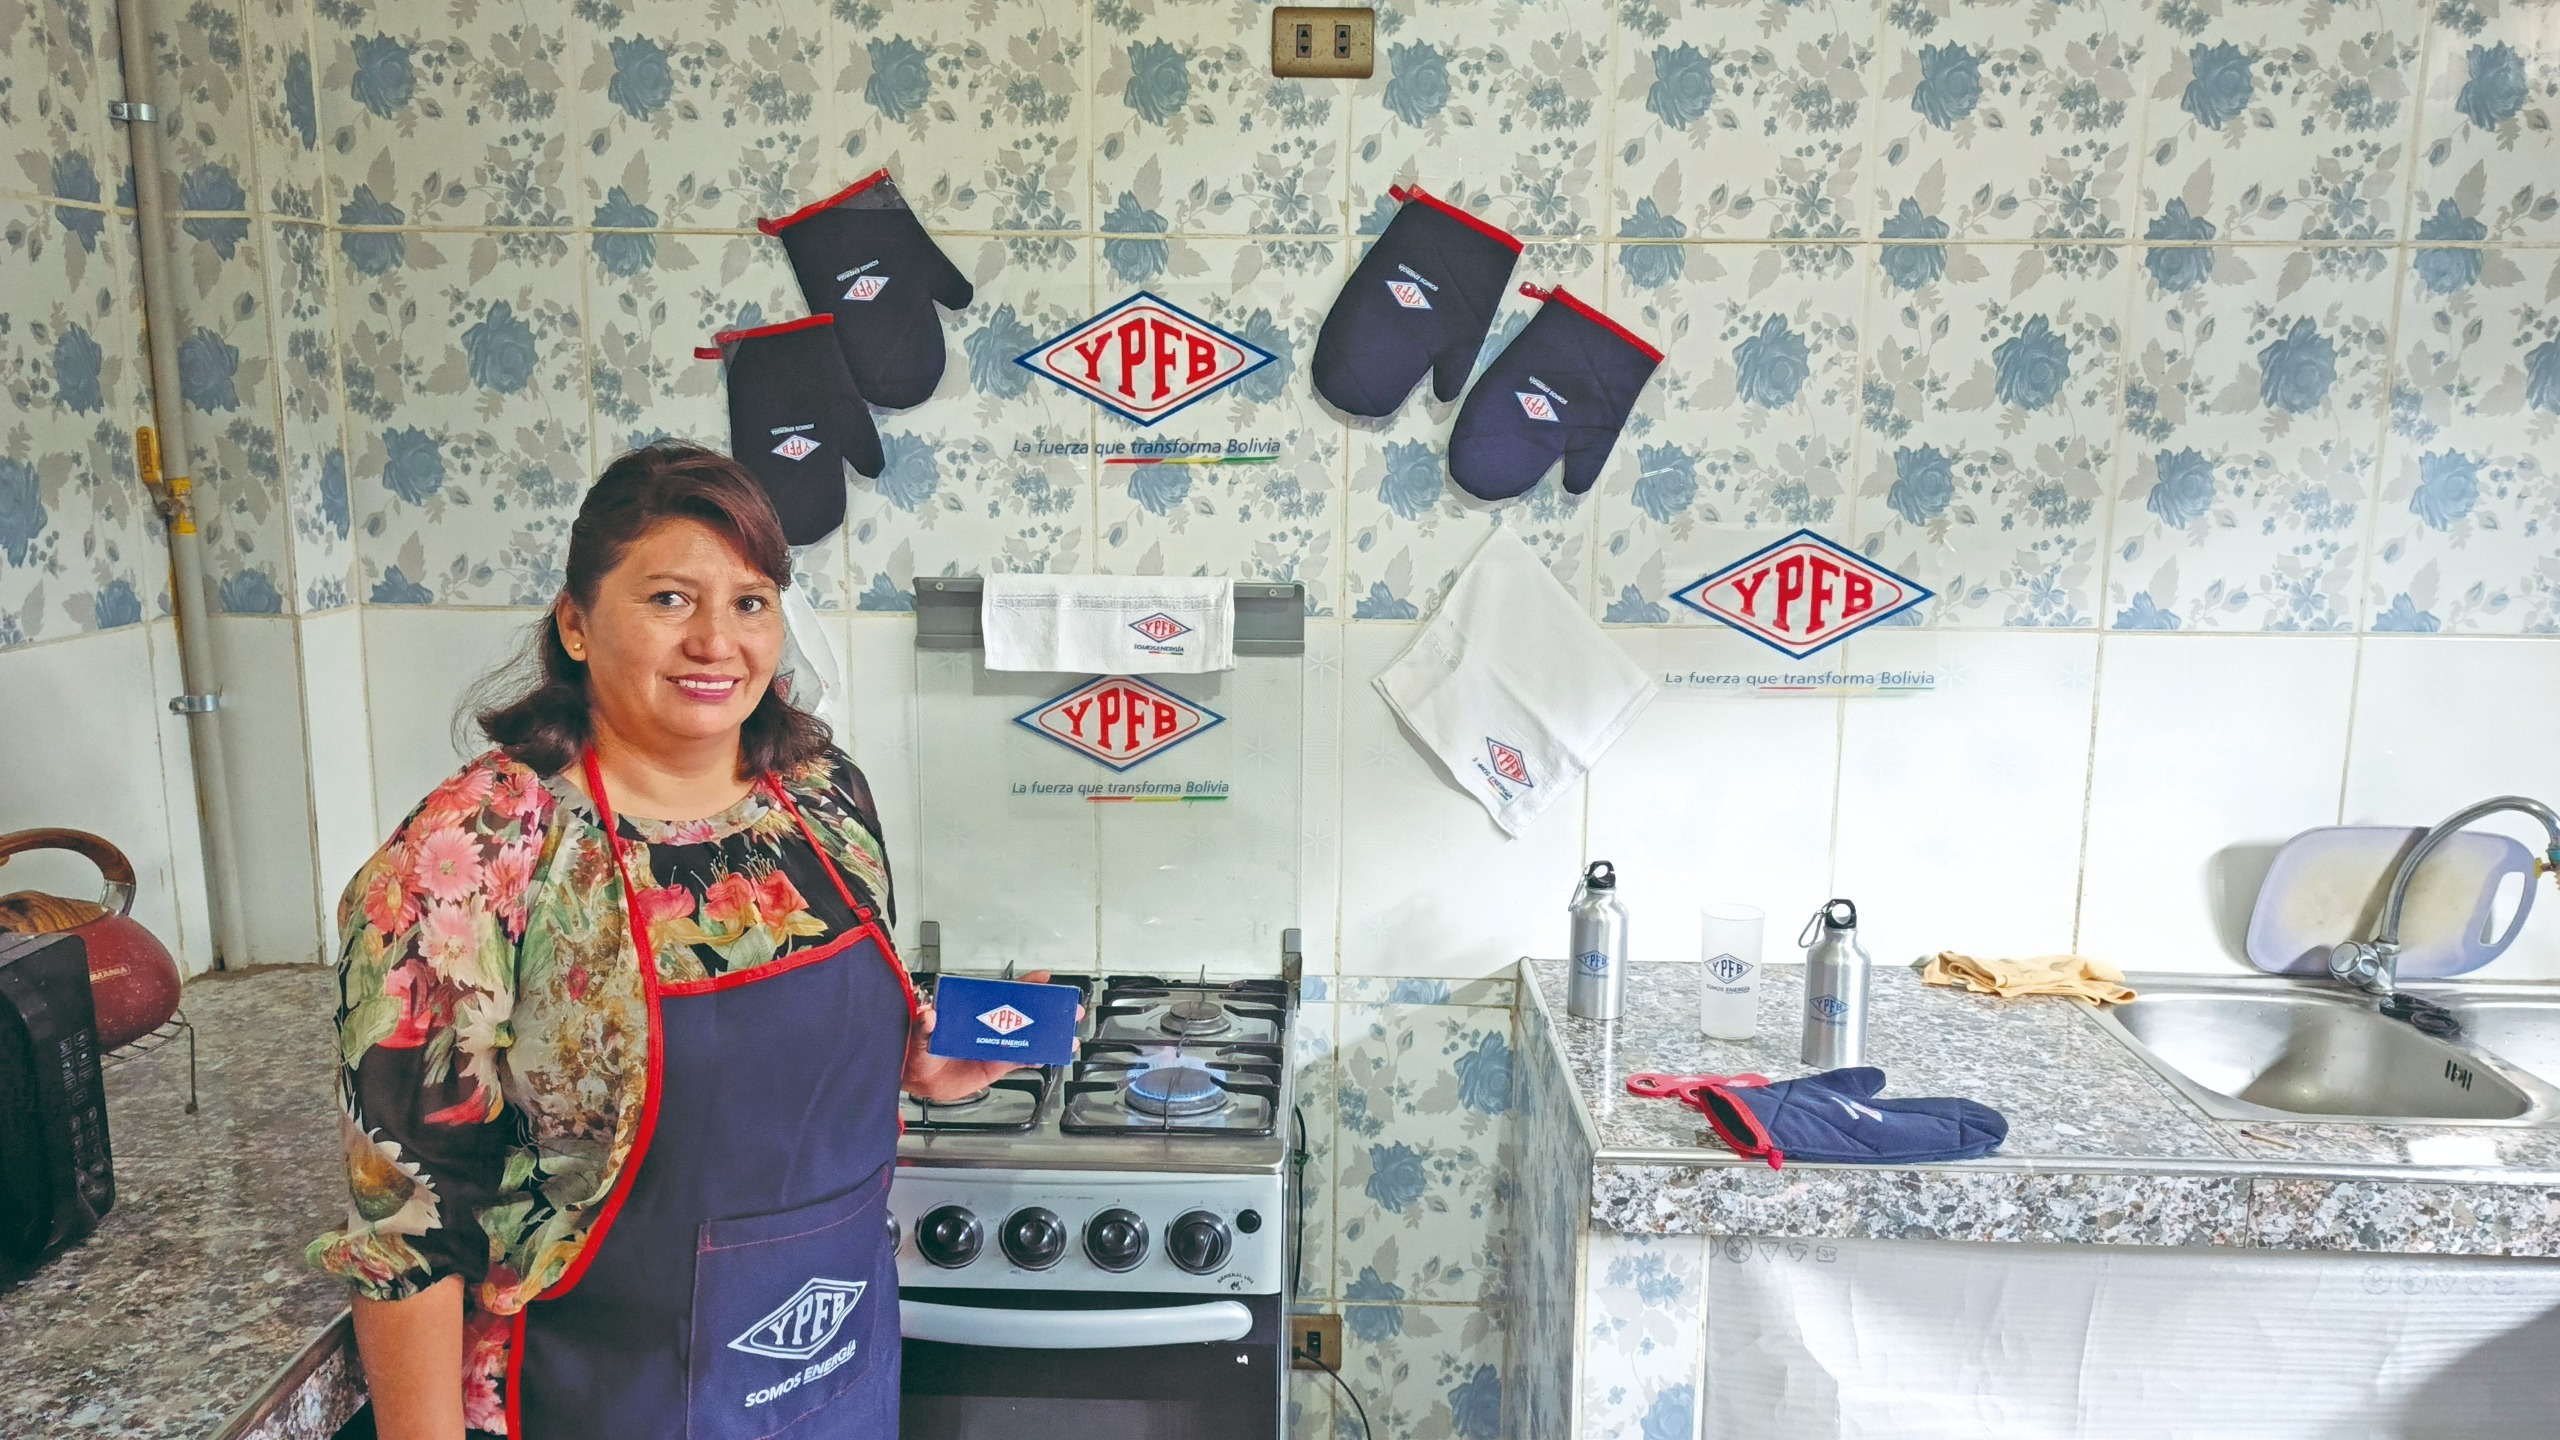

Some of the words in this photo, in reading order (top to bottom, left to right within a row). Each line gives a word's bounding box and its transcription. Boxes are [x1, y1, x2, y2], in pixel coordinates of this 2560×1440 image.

[853, 280, 881, 297] YPFB
[1395, 284, 1421, 304] YPFB
[1075, 317, 1217, 401] YPFB
[1524, 396, 1549, 417] YPFB
[782, 440, 811, 456] YPFB
[1013, 439, 1031, 453] La
[1037, 439, 1088, 454] fuerza
[1095, 442, 1125, 458] que
[1131, 438, 1221, 454] transforma
[1226, 438, 1281, 453] Bolivia
[1731, 554, 1874, 635] YPFB
[1145, 620, 1176, 636] YPFB
[1665, 672, 1683, 684] La
[1688, 671, 1741, 684] fuerza
[1746, 675, 1778, 686] que
[1783, 672, 1875, 685] transforma
[1881, 671, 1935, 684] Bolivia
[1061, 687, 1178, 752] YPFB
[1472, 757, 1491, 777] SMOS
[1497, 747, 1522, 778] YPFB
[1012, 781, 1027, 794] La
[1031, 781, 1074, 794] fuerza
[1078, 784, 1104, 799] que
[1108, 781, 1182, 794] transforma
[1186, 781, 1230, 794] Bolivia
[1712, 959, 1743, 978] YPFB
[988, 1009, 1023, 1030] YPFB
[975, 1037, 1000, 1045] SOMOS
[1001, 1039, 1029, 1047] ENERGÍA
[769, 1292, 846, 1345] YPFB
[744, 1372, 802, 1408] SOMOS
[803, 1339, 857, 1380] ENERGÍA
